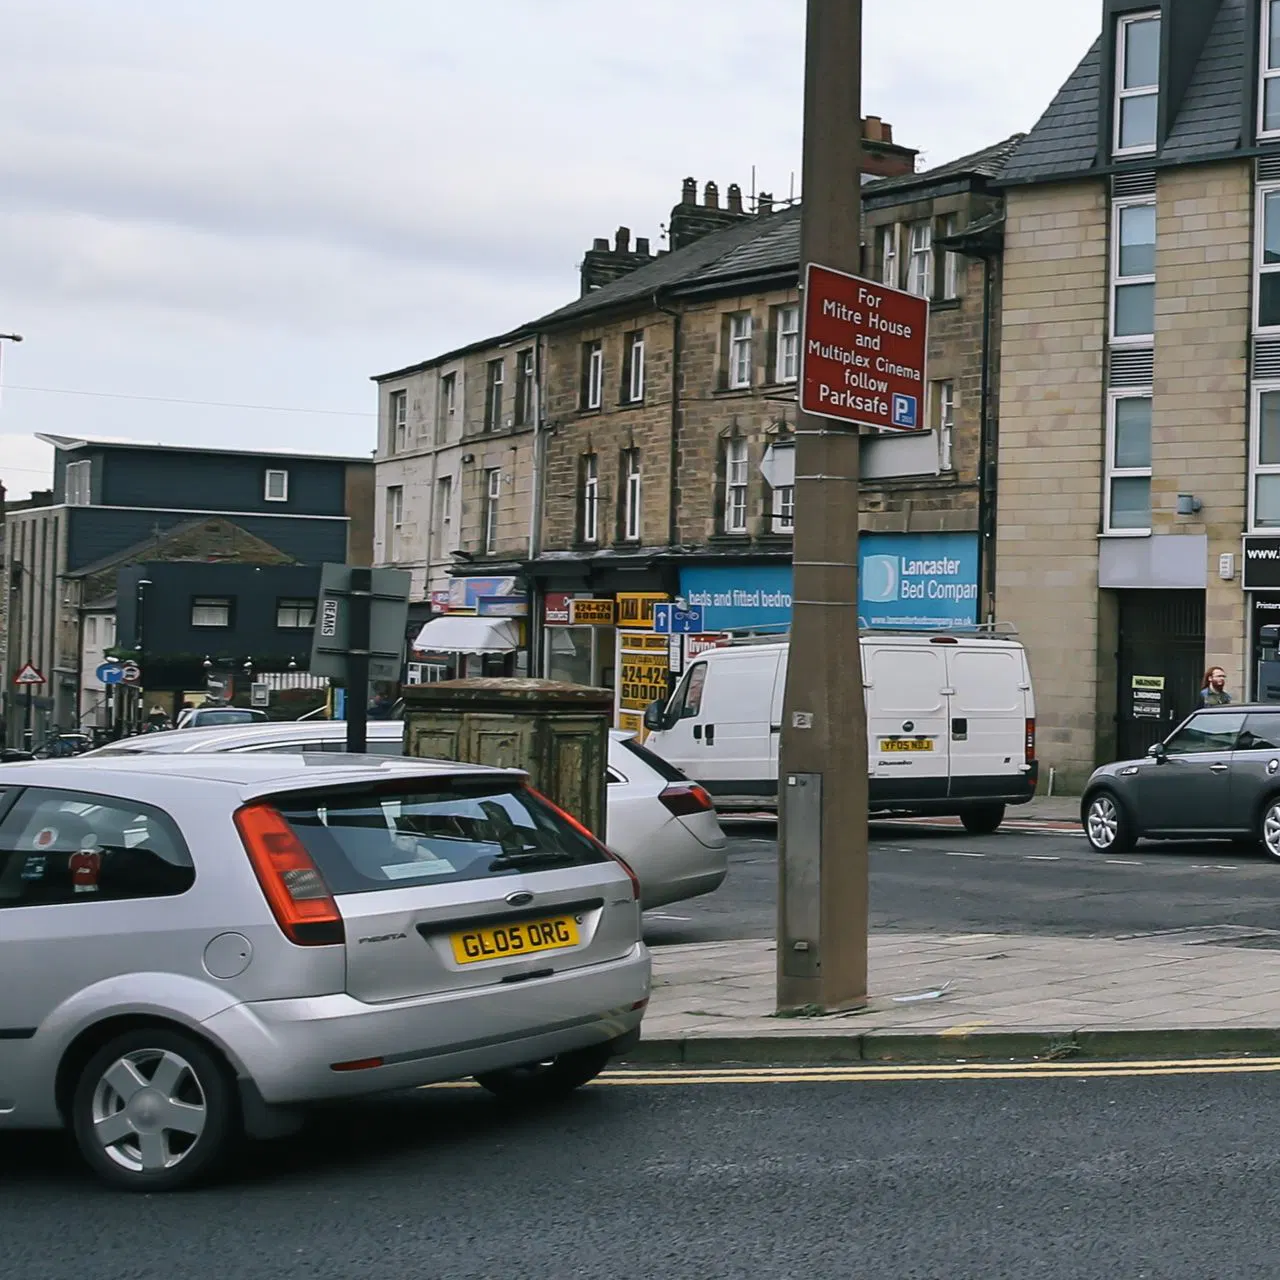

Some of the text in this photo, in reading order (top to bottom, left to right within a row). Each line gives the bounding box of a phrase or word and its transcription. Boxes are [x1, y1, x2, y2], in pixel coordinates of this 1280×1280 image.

[858, 287, 882, 308] For
[823, 299, 912, 338] Mitre House
[855, 333, 880, 351] and
[808, 339, 920, 381] Multiplex Cinema
[844, 369, 888, 393] follow
[819, 384, 889, 415] Parksafe
[901, 556, 961, 575] Lancaster
[688, 589, 792, 607] beds and fitted bedro
[901, 580, 978, 603] Bed Compan
[322, 600, 336, 635] REAMS
[462, 927, 524, 958] GL05
